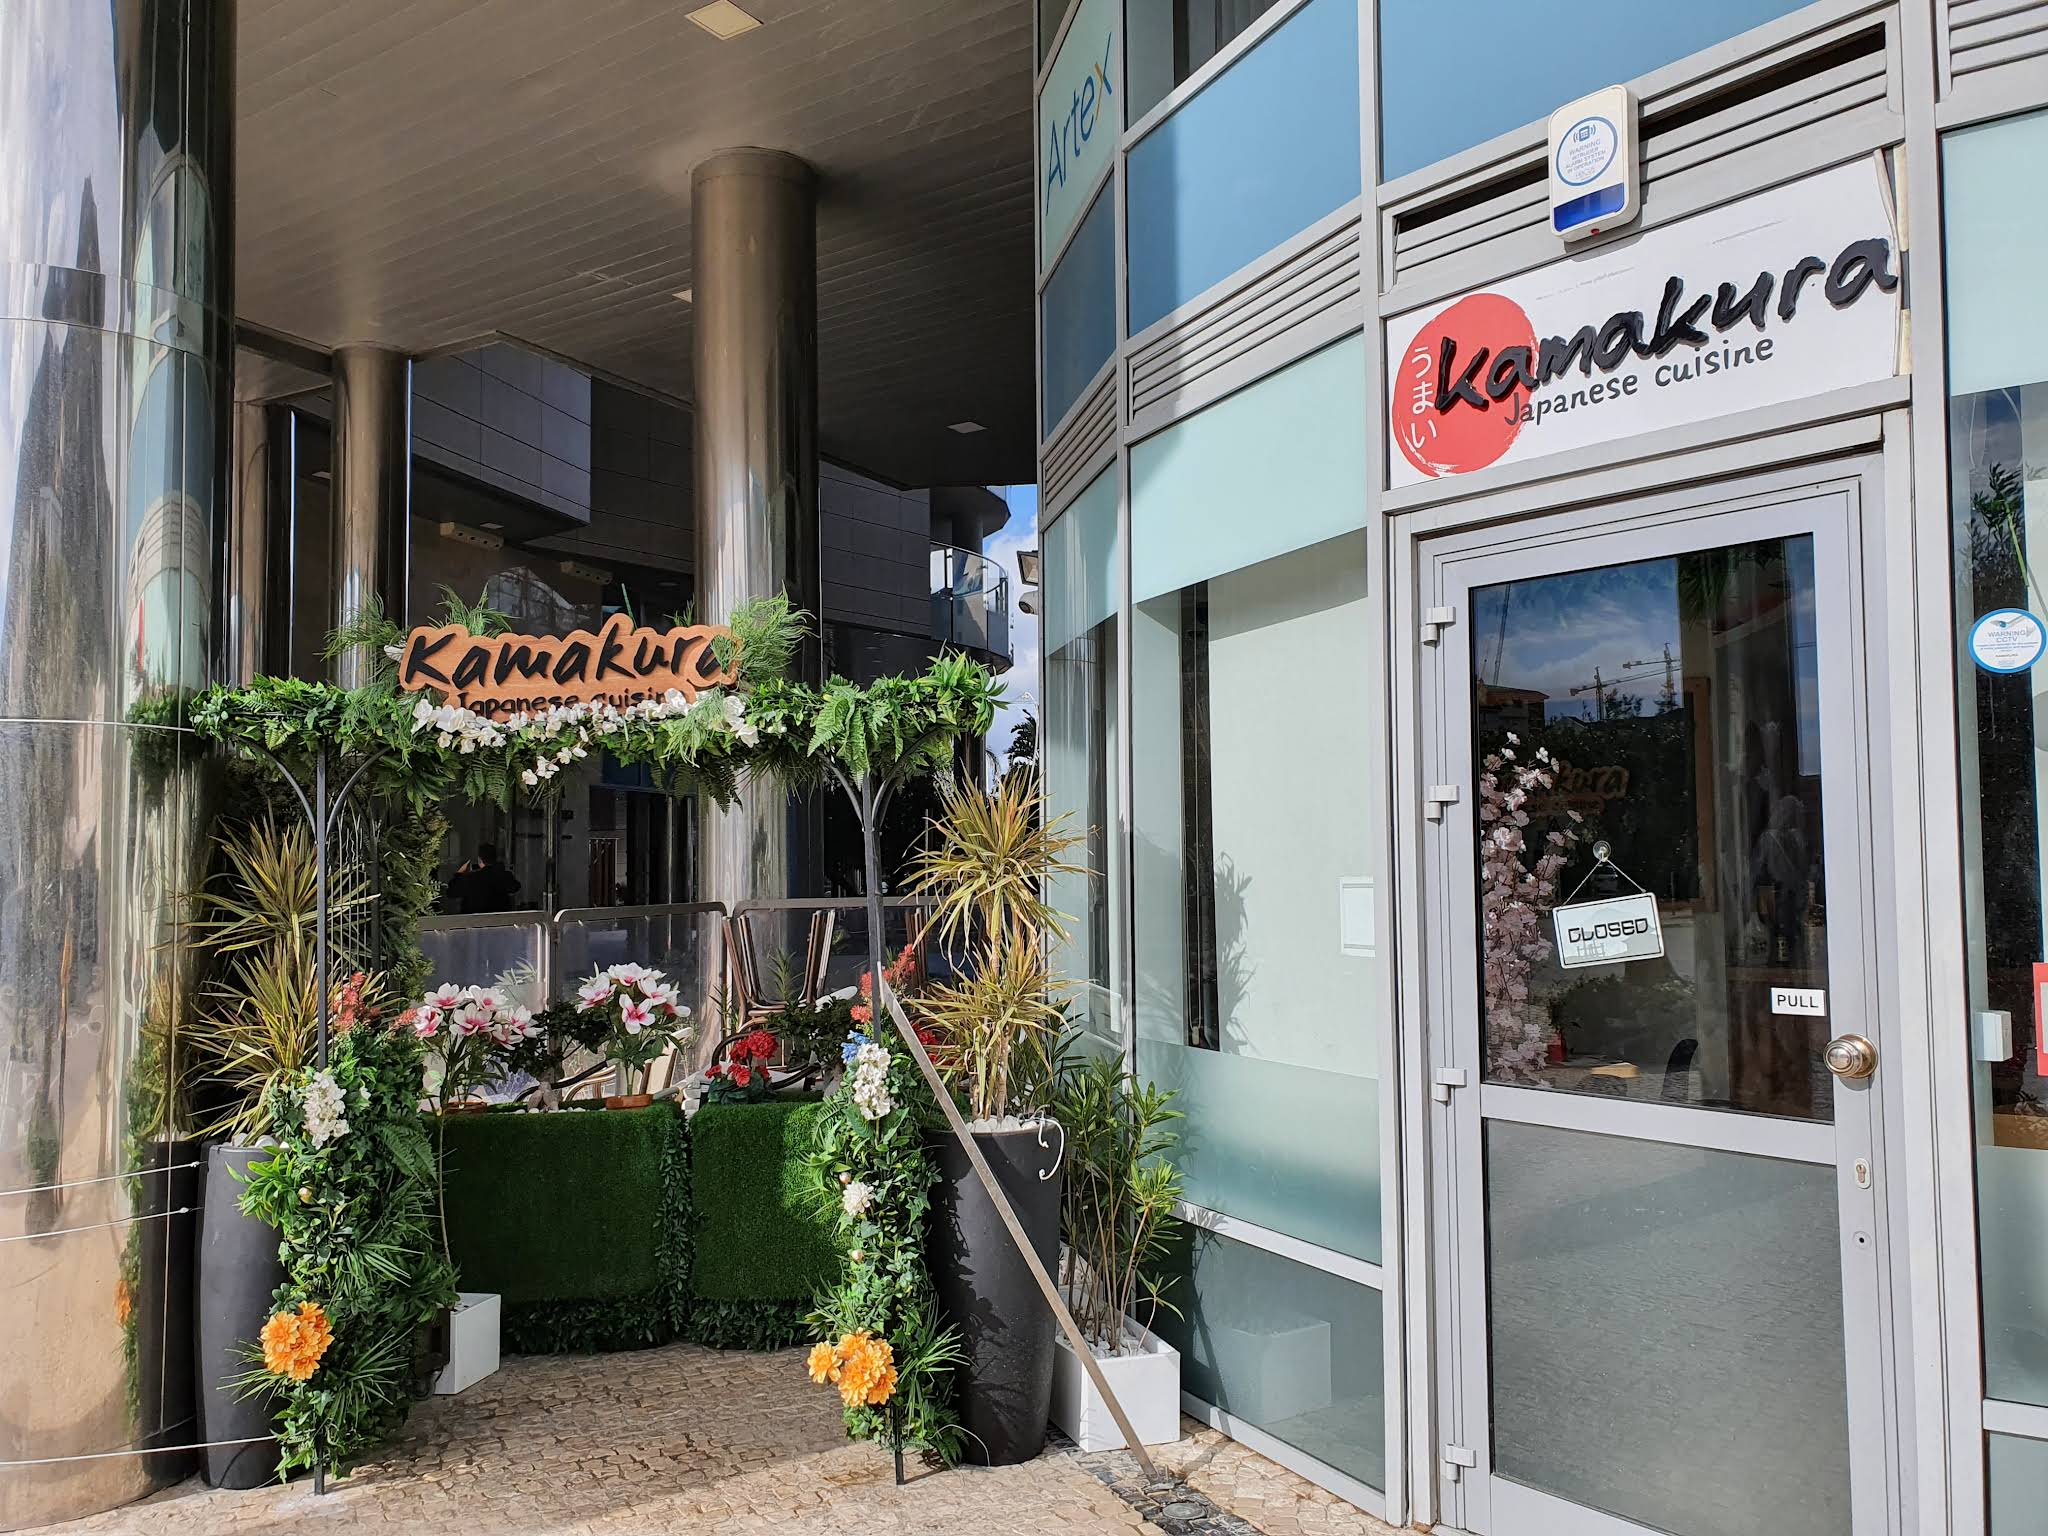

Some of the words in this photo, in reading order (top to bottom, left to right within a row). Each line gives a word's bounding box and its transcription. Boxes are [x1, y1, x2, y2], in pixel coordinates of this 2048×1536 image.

[1046, 32, 1113, 216] Artex
[1569, 138, 1600, 155] WARNING
[1584, 150, 1605, 161] SYSTEM
[1505, 373, 1638, 426] Japanese
[1655, 338, 1774, 388] cuisine
[1411, 346, 1437, 448] うまい
[1988, 630, 2026, 638] WARNING
[1568, 918, 1649, 943] CLOSED
[1777, 994, 1819, 1008] PULL
